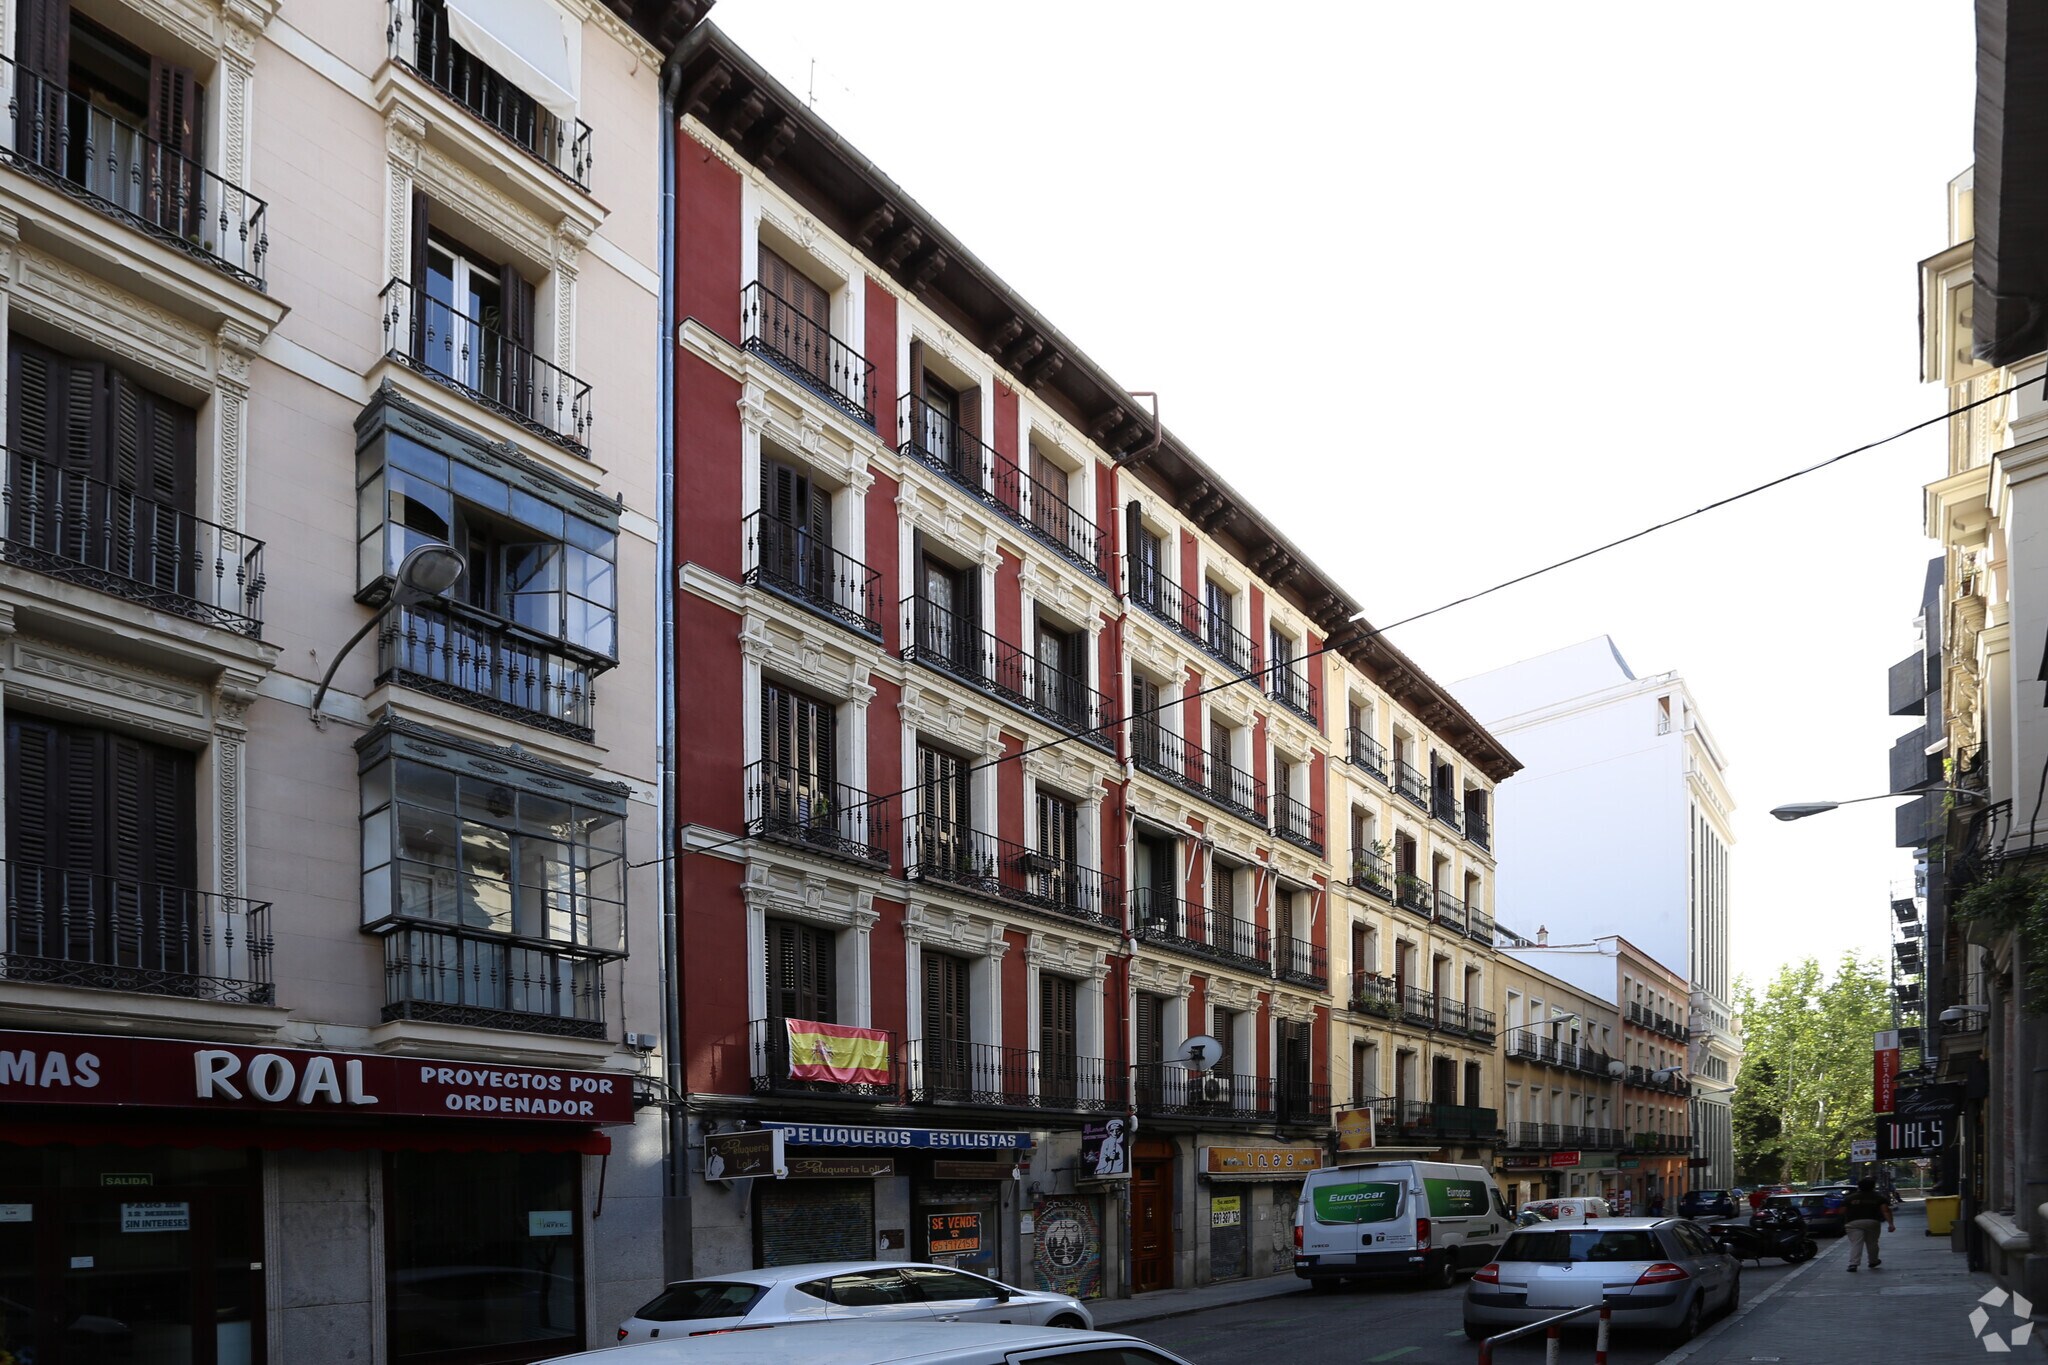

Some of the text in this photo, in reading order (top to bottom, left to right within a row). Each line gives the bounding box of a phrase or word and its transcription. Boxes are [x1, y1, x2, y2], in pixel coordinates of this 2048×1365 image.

[194, 1050, 379, 1105] ROAL
[420, 1066, 614, 1094] PROYECTOS POR
[1882, 1051, 1891, 1111] RESTAURANTE
[445, 1093, 594, 1116] ORDENADOR
[785, 1127, 1017, 1147] PELUQUEROS ESTILISTAS
[795, 1160, 860, 1175] Peluqueria
[106, 1177, 149, 1186] SALIDA
[1329, 1191, 1386, 1203] Europcar
[1446, 1187, 1472, 1199] Europcar
[125, 1218, 188, 1228] SIN INTERESES
[932, 1216, 977, 1230] SE VENDE
